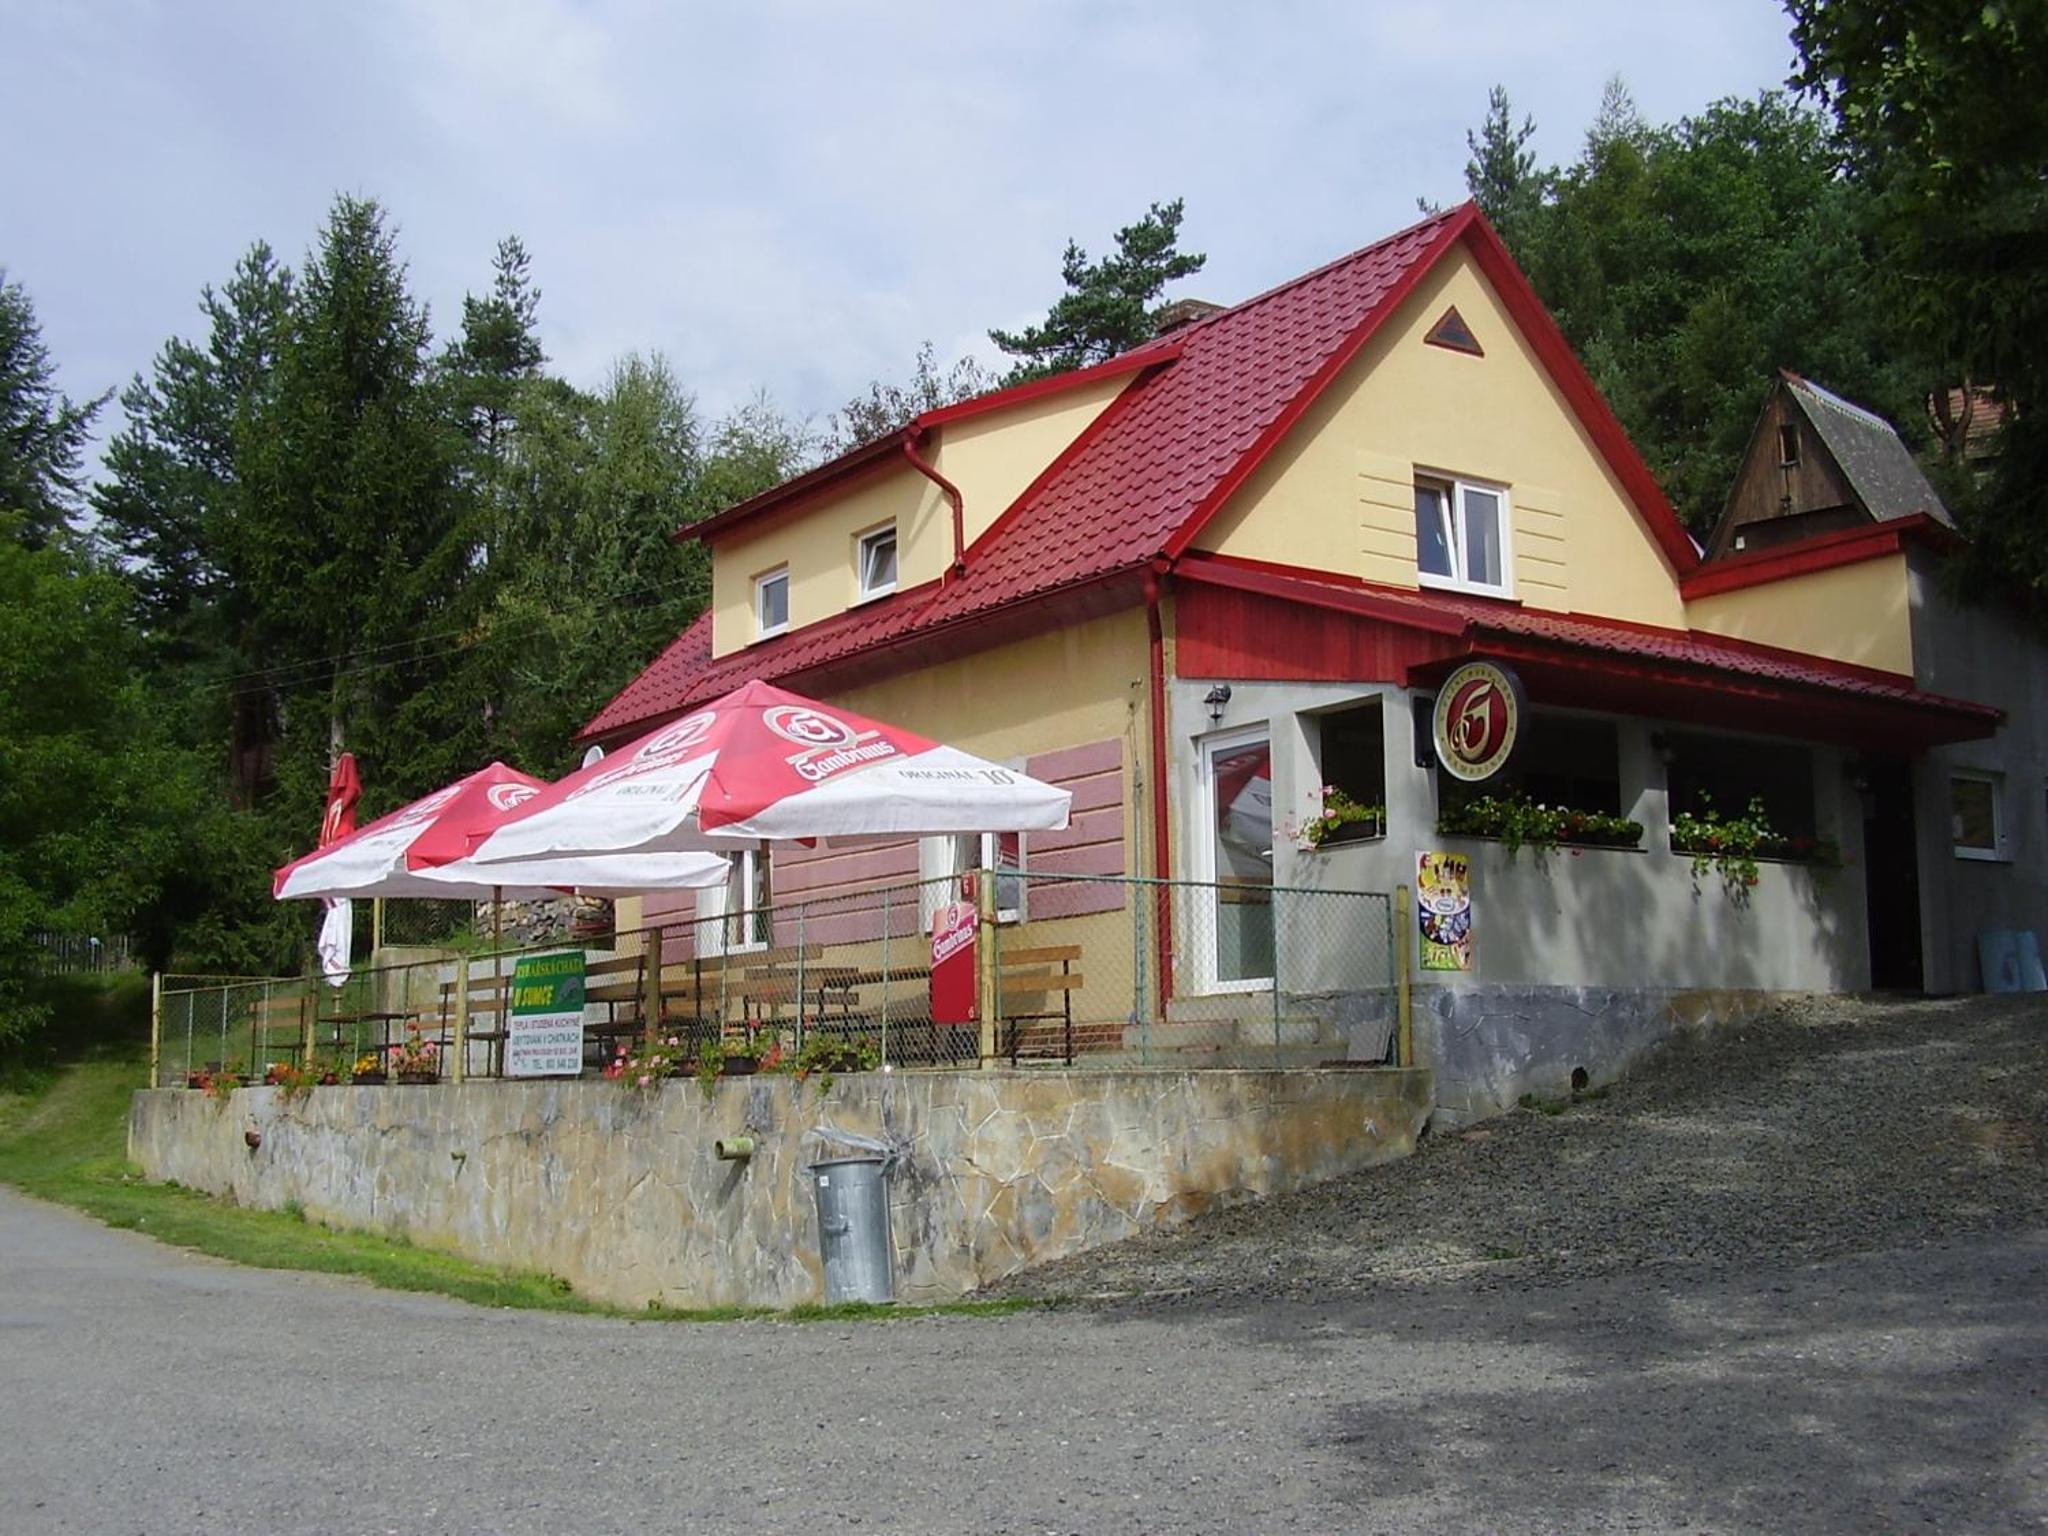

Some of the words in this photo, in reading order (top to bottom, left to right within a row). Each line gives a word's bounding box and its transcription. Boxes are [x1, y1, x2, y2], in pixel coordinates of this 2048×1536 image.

[795, 740, 896, 781] Gambrinus
[978, 769, 1016, 786] 10
[933, 924, 973, 959] Gambrinus
